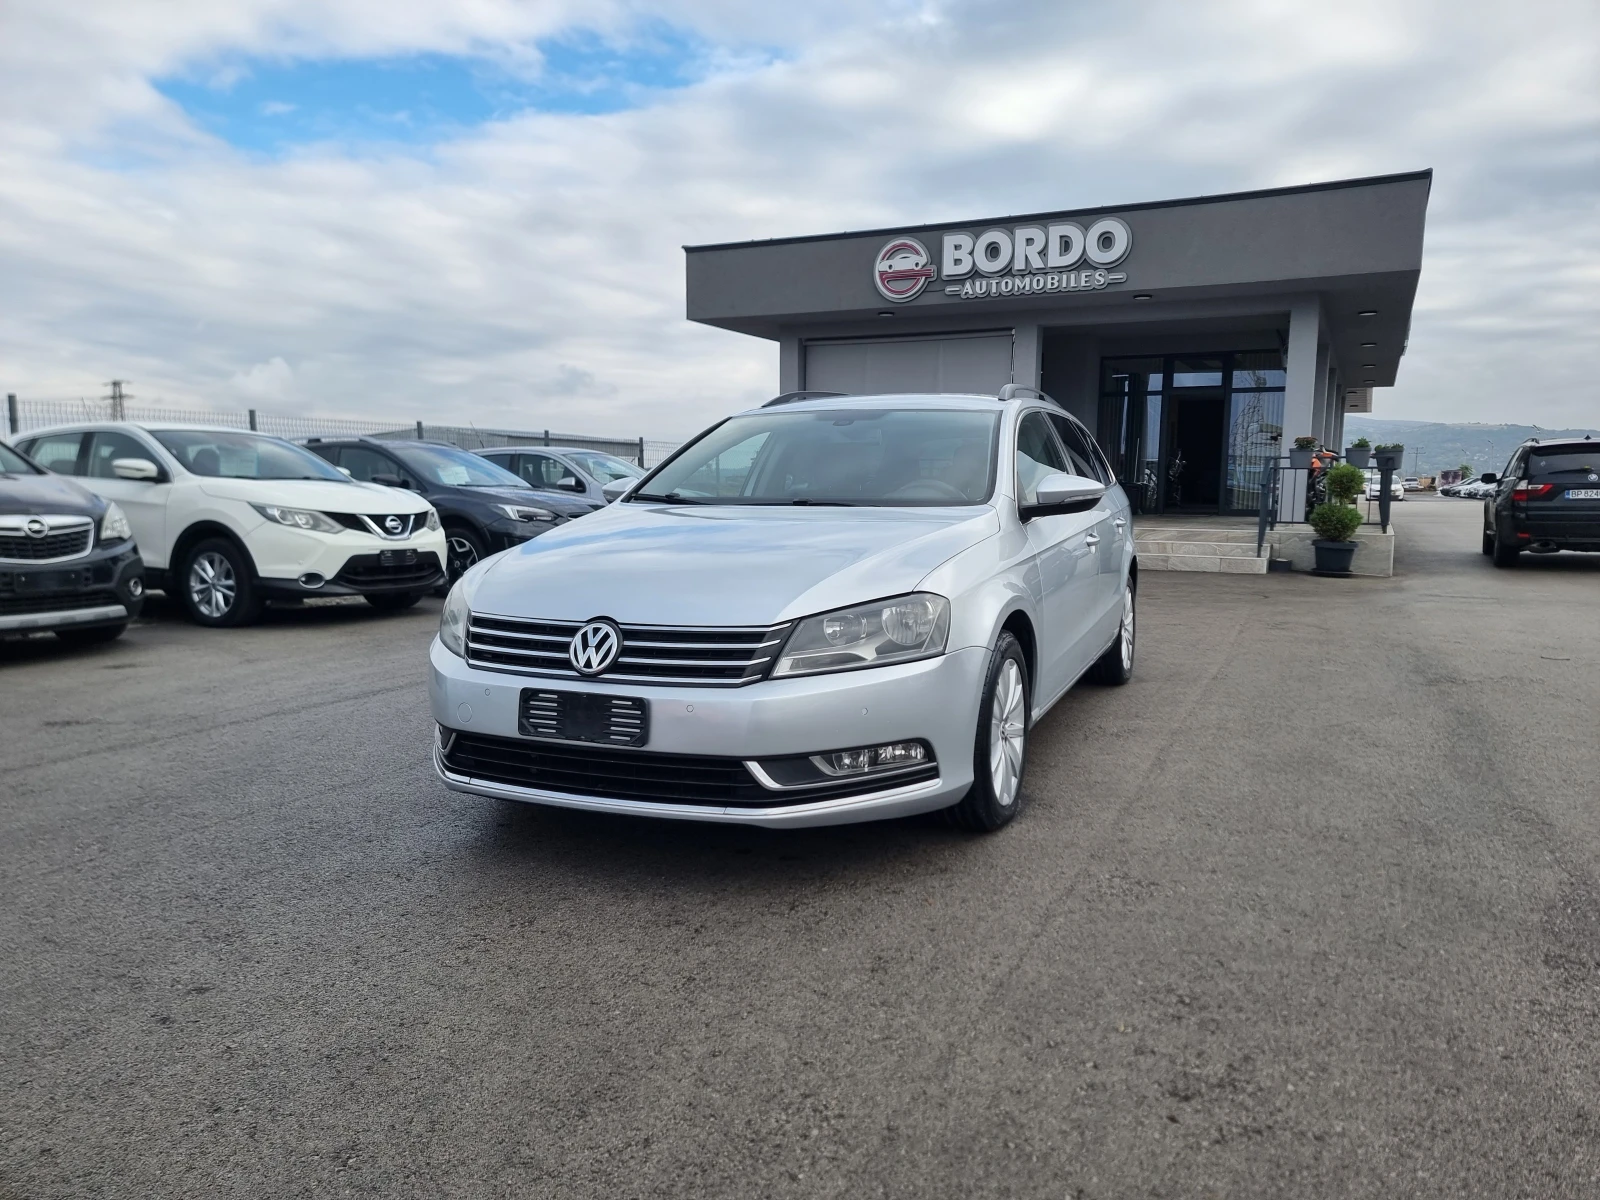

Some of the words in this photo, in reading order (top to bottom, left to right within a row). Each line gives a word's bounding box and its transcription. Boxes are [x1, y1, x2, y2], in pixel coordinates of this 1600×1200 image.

[943, 220, 1128, 276] BORDO
[963, 271, 1105, 295] AUTOMOBILES
[1571, 490, 1582, 498] BP
[1584, 490, 1600, 498] 824
